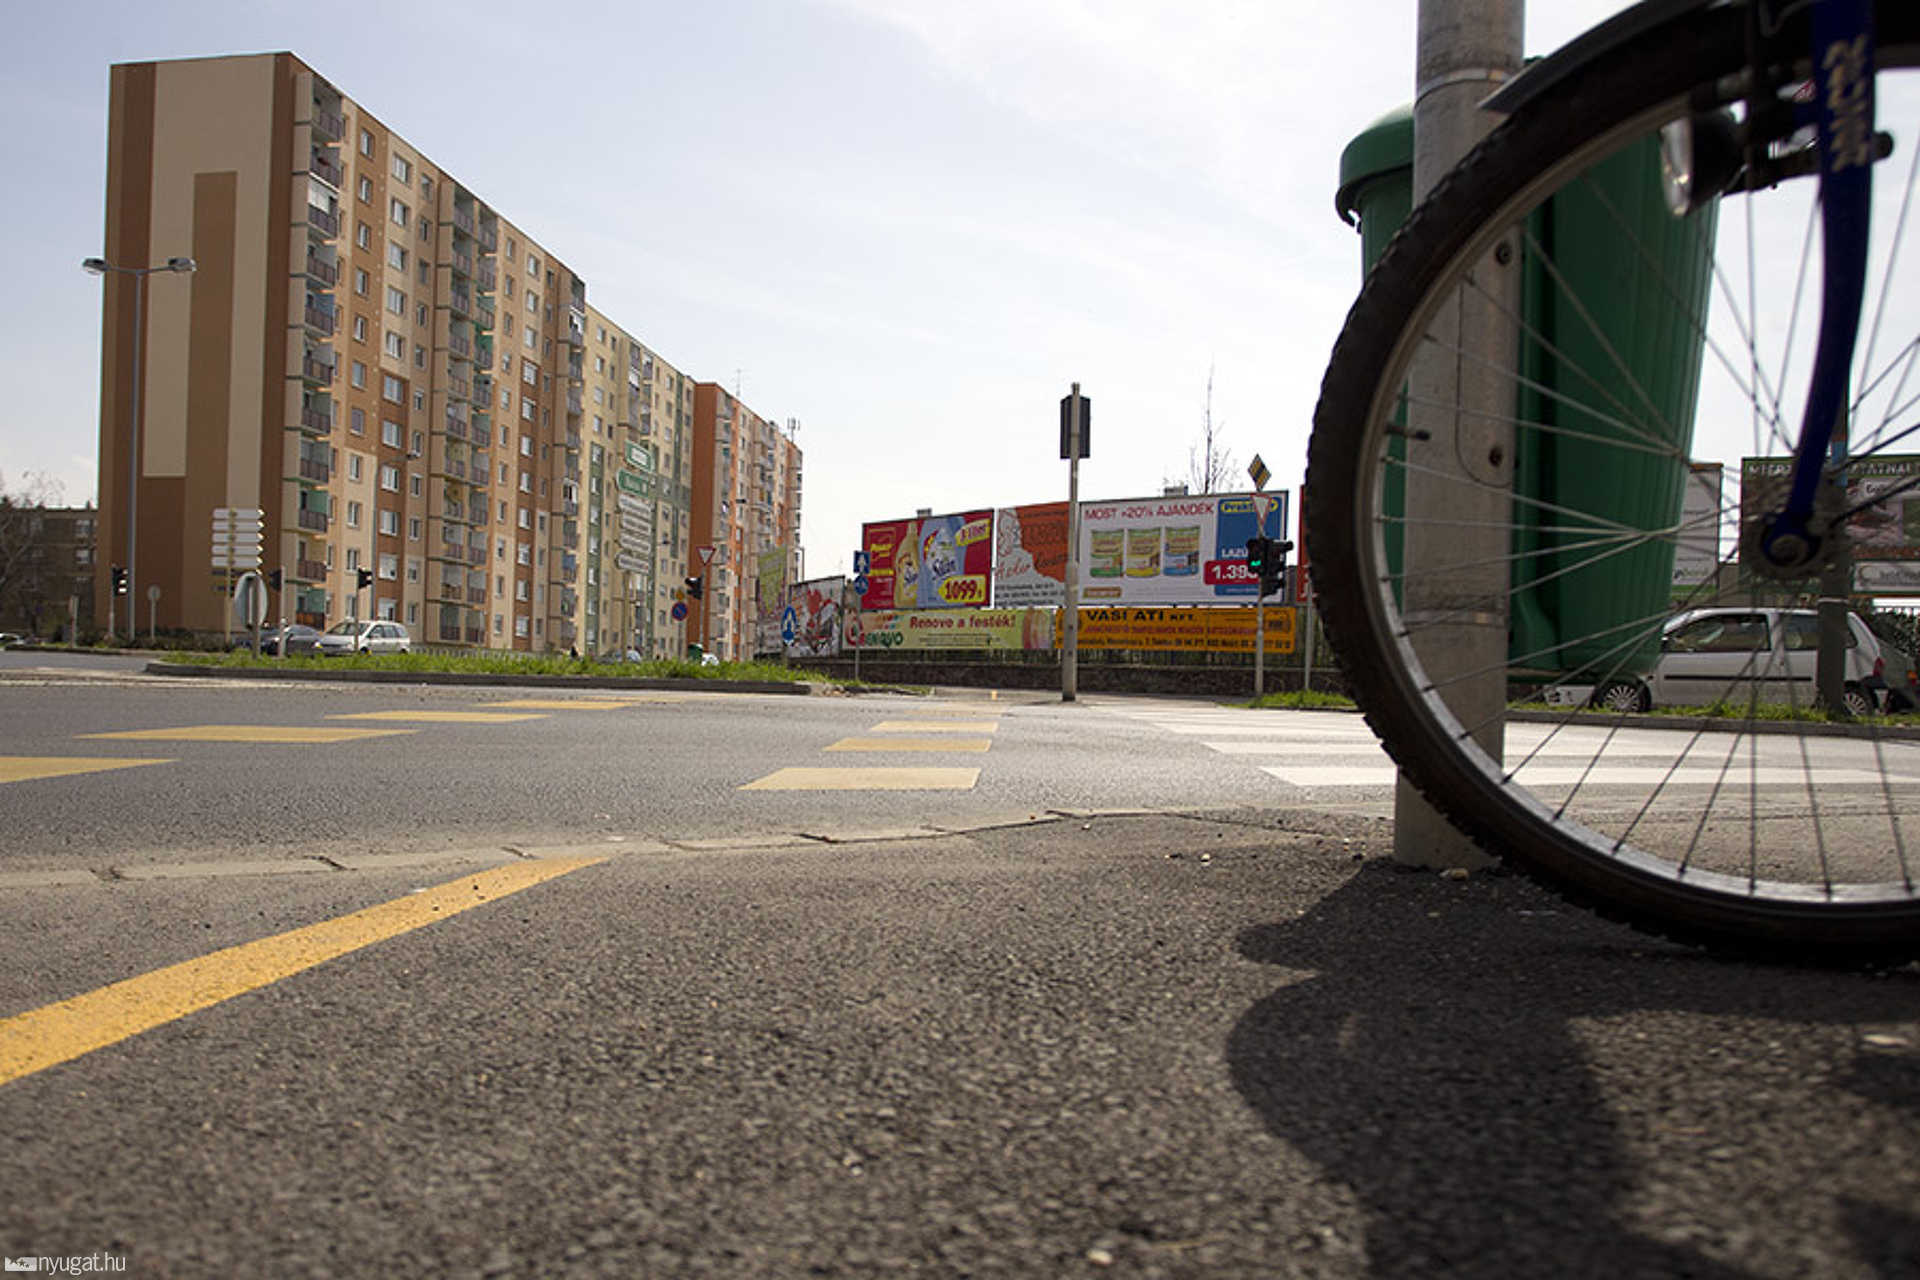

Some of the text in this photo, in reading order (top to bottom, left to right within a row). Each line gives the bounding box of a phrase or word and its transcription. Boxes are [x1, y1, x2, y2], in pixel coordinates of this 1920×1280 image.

[1084, 507, 1117, 520] MOST
[944, 580, 977, 600] 1099
[1085, 609, 1128, 621] VASI
[1134, 609, 1164, 621] ATI
[909, 616, 954, 629] Renovo
[957, 617, 965, 628] a
